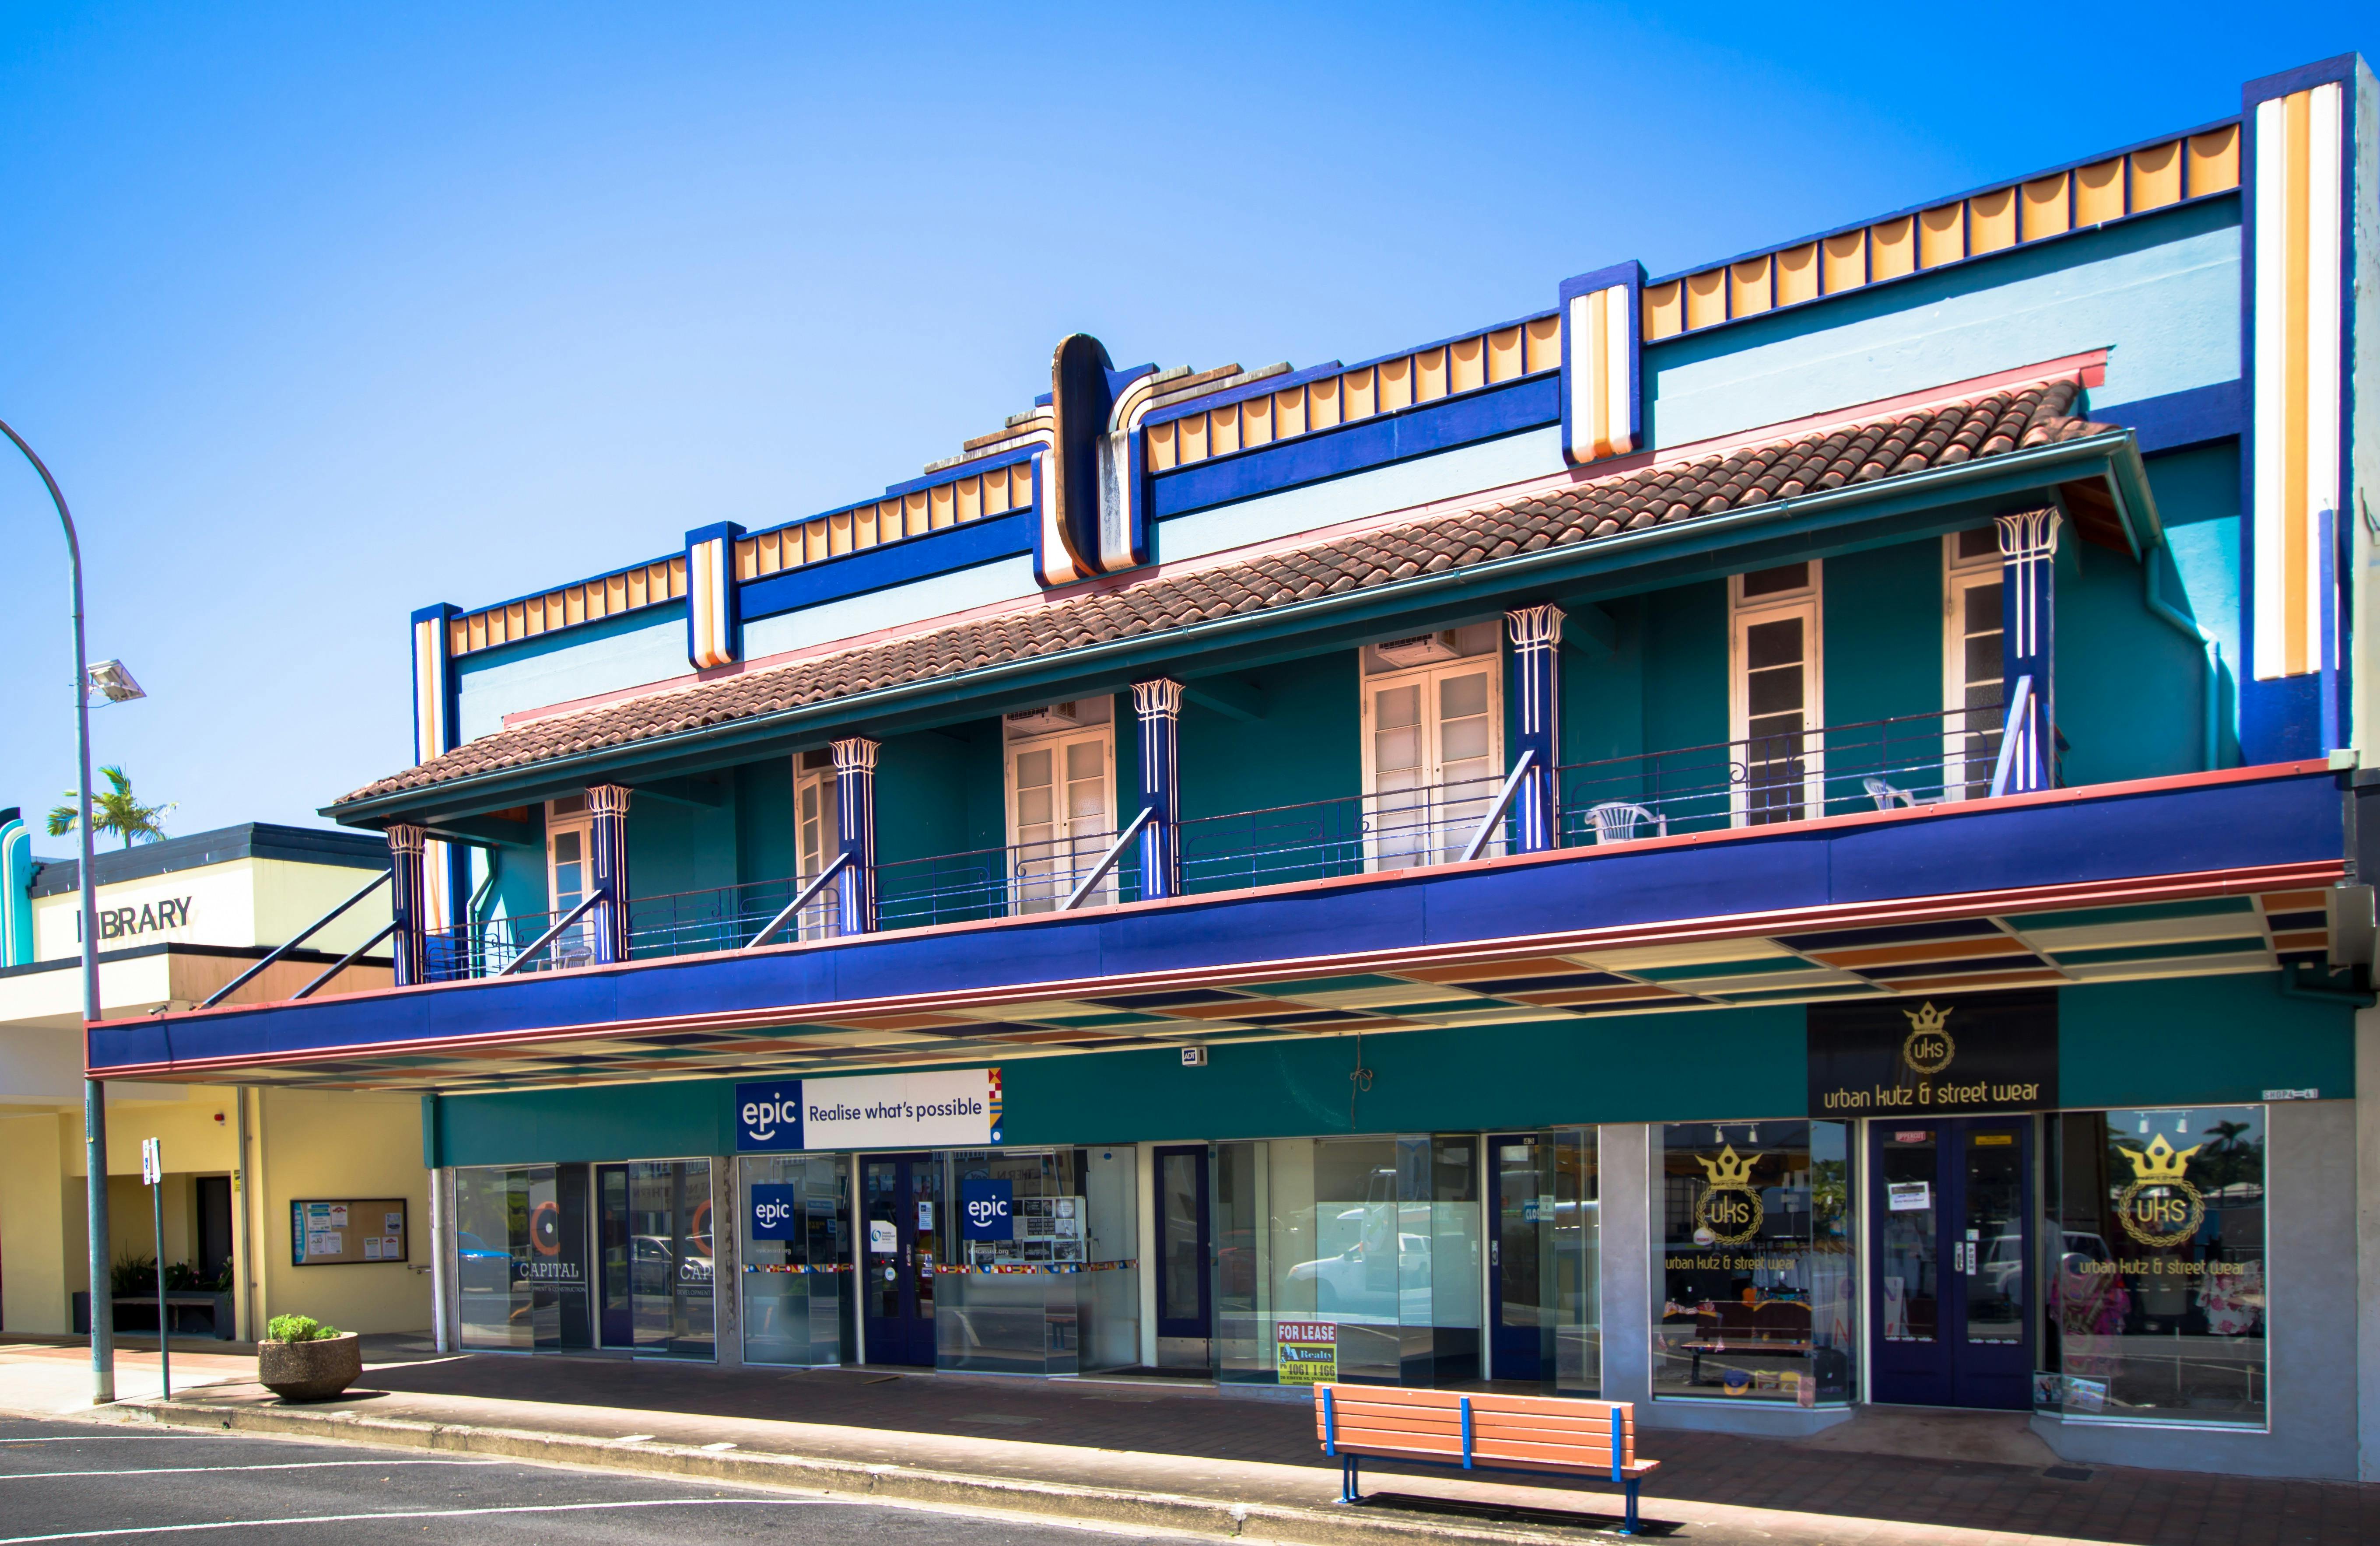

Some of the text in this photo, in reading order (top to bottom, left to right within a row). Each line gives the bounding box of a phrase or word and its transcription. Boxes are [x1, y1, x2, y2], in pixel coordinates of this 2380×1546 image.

[1914, 1038, 1944, 1059] uks
[1824, 1081, 2039, 1108] urban kutz & street wear
[743, 1092, 796, 1132] epic
[809, 1097, 982, 1122] Realise what's possible
[756, 1198, 789, 1223] epic
[968, 1194, 1007, 1221] epic
[1711, 1195, 1749, 1223] uks
[2137, 1194, 2187, 1222] uks
[520, 1262, 578, 1277] CAPITAL
[1665, 1255, 1796, 1270] urban kutz & street wear
[2079, 1257, 2245, 1274] urban kutz & street wear
[1279, 1325, 1335, 1340] FOR LEASE
[1300, 1350, 1332, 1360] Realty
[1288, 1364, 1309, 1375] 4061
[1314, 1364, 1335, 1377] 1466
